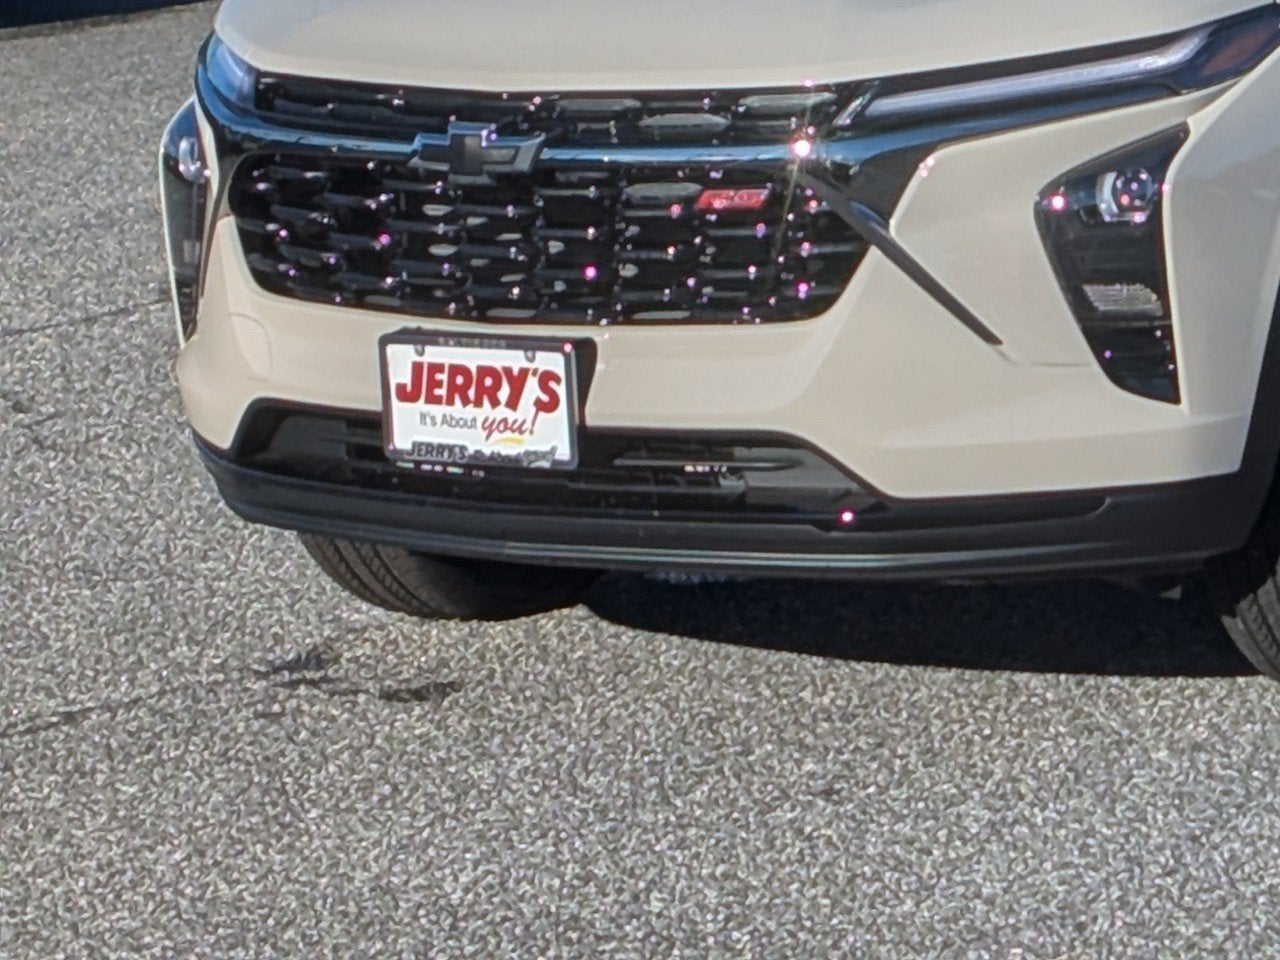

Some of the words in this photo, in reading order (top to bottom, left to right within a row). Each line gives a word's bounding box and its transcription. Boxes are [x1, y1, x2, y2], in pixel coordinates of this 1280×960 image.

[395, 361, 562, 414] JERRY'S
[419, 411, 437, 426] It's
[440, 414, 478, 429] About
[481, 407, 540, 442] you!
